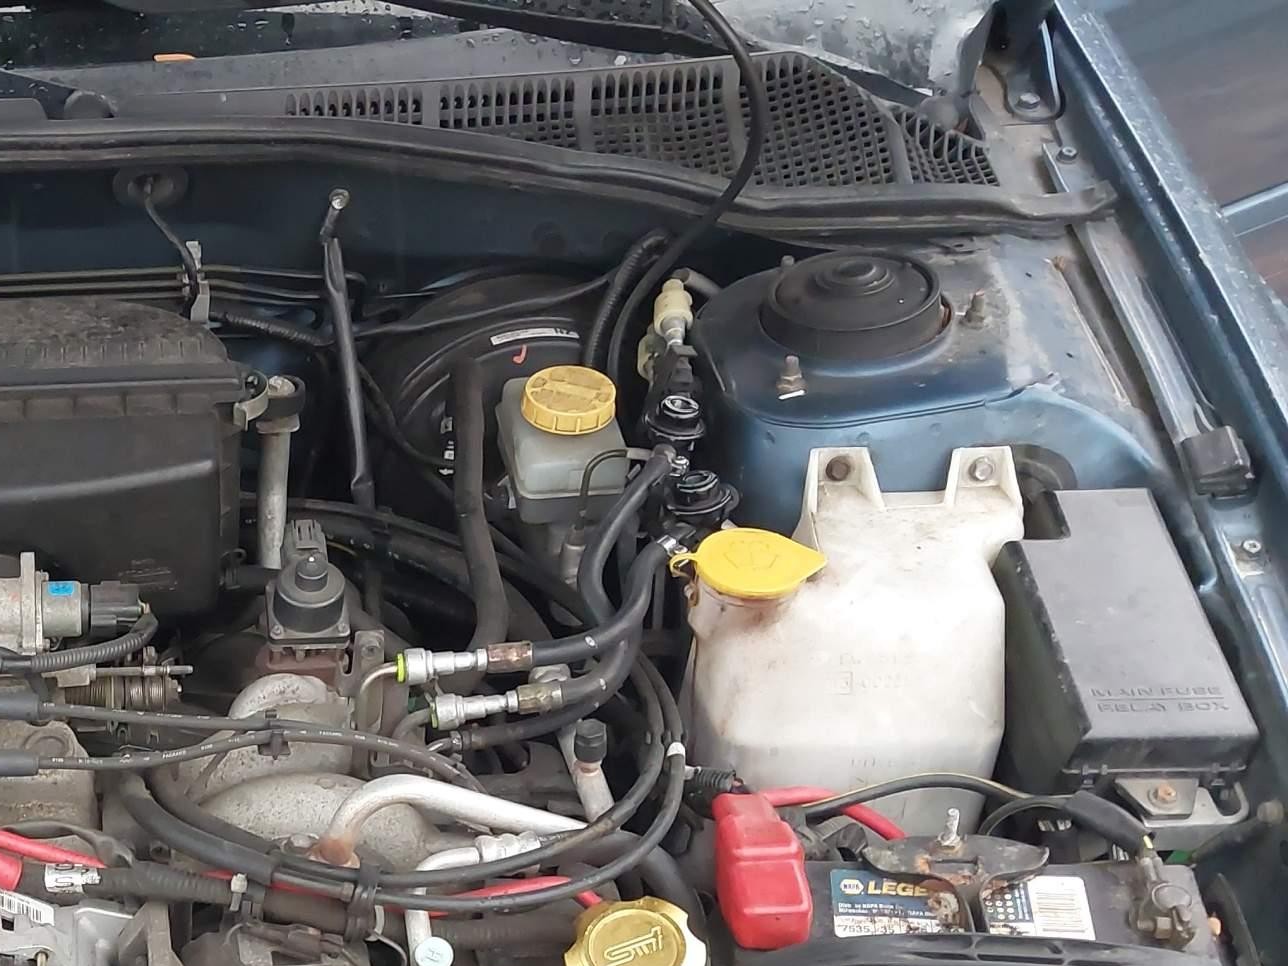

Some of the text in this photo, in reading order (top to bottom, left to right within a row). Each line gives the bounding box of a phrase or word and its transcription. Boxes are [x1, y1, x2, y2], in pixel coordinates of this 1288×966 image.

[1089, 686, 1224, 698] MAIN FUSE
[1097, 702, 1230, 713] RELAY BOX
[867, 879, 929, 897] LEGE
